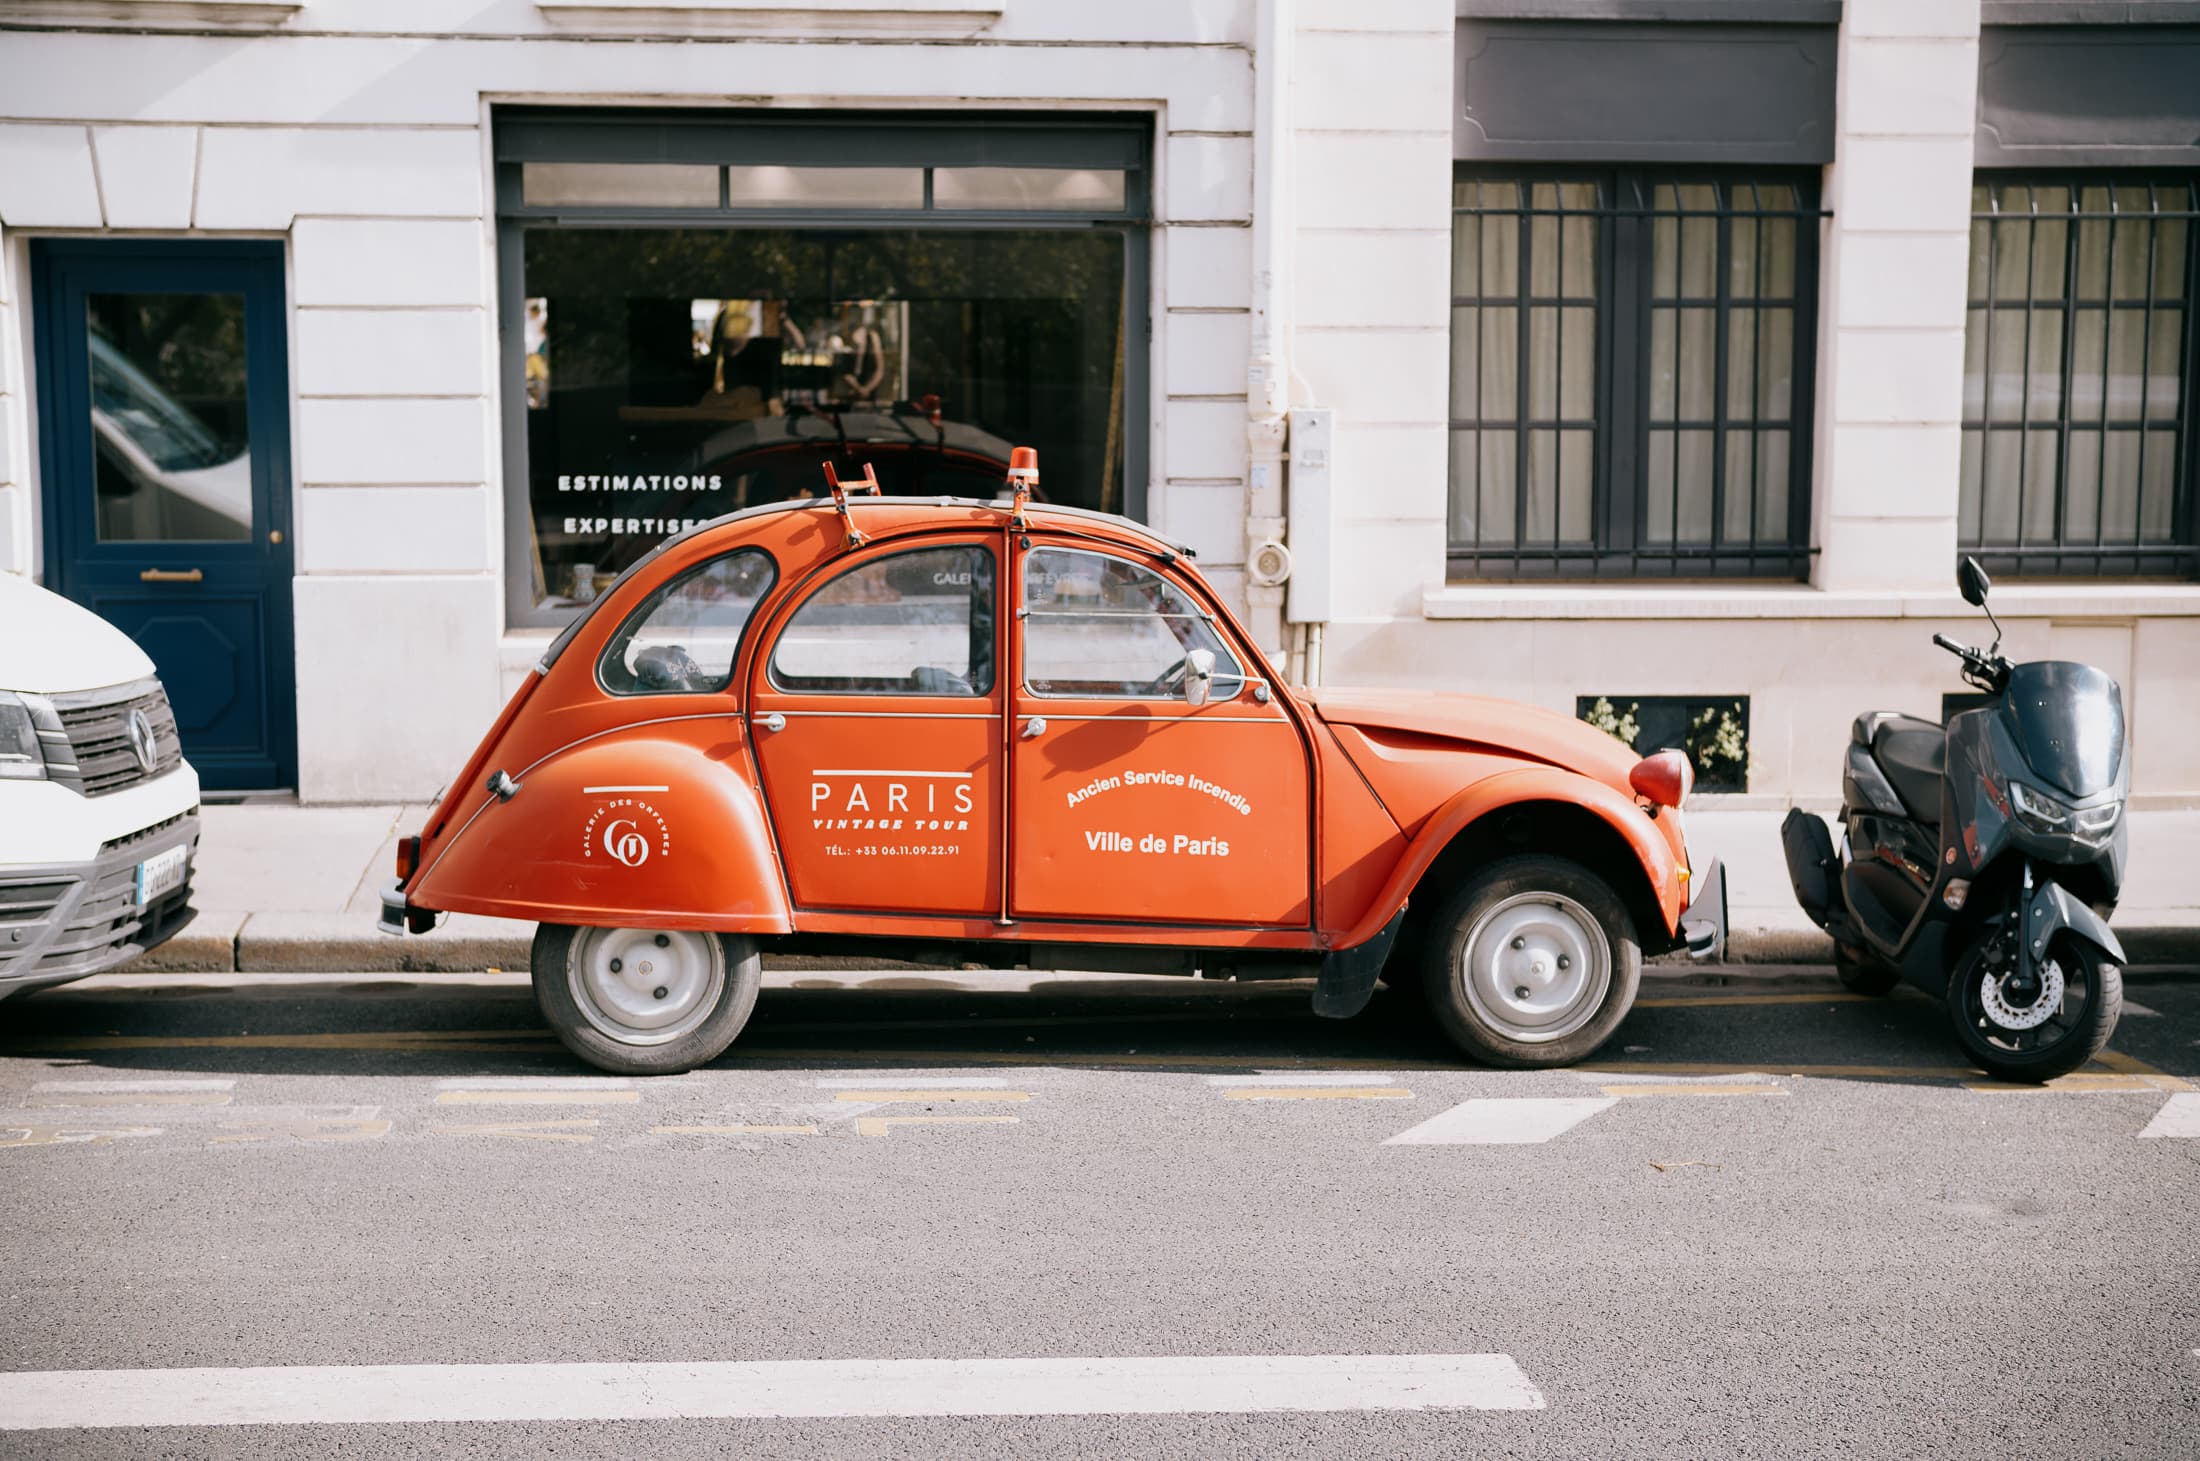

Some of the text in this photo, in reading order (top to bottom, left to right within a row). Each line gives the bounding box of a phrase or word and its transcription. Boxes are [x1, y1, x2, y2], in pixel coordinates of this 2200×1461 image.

[558, 475, 722, 491] ESTIMATIONS
[811, 783, 973, 813] PARIS
[1066, 770, 1251, 816] Ancien Service Incendie
[813, 819, 969, 831] VINTAGE TOUR
[855, 846, 877, 855] +33
[881, 845, 959, 855] 06.11.09.22.91
[1085, 831, 1230, 857] Ville de Paris
